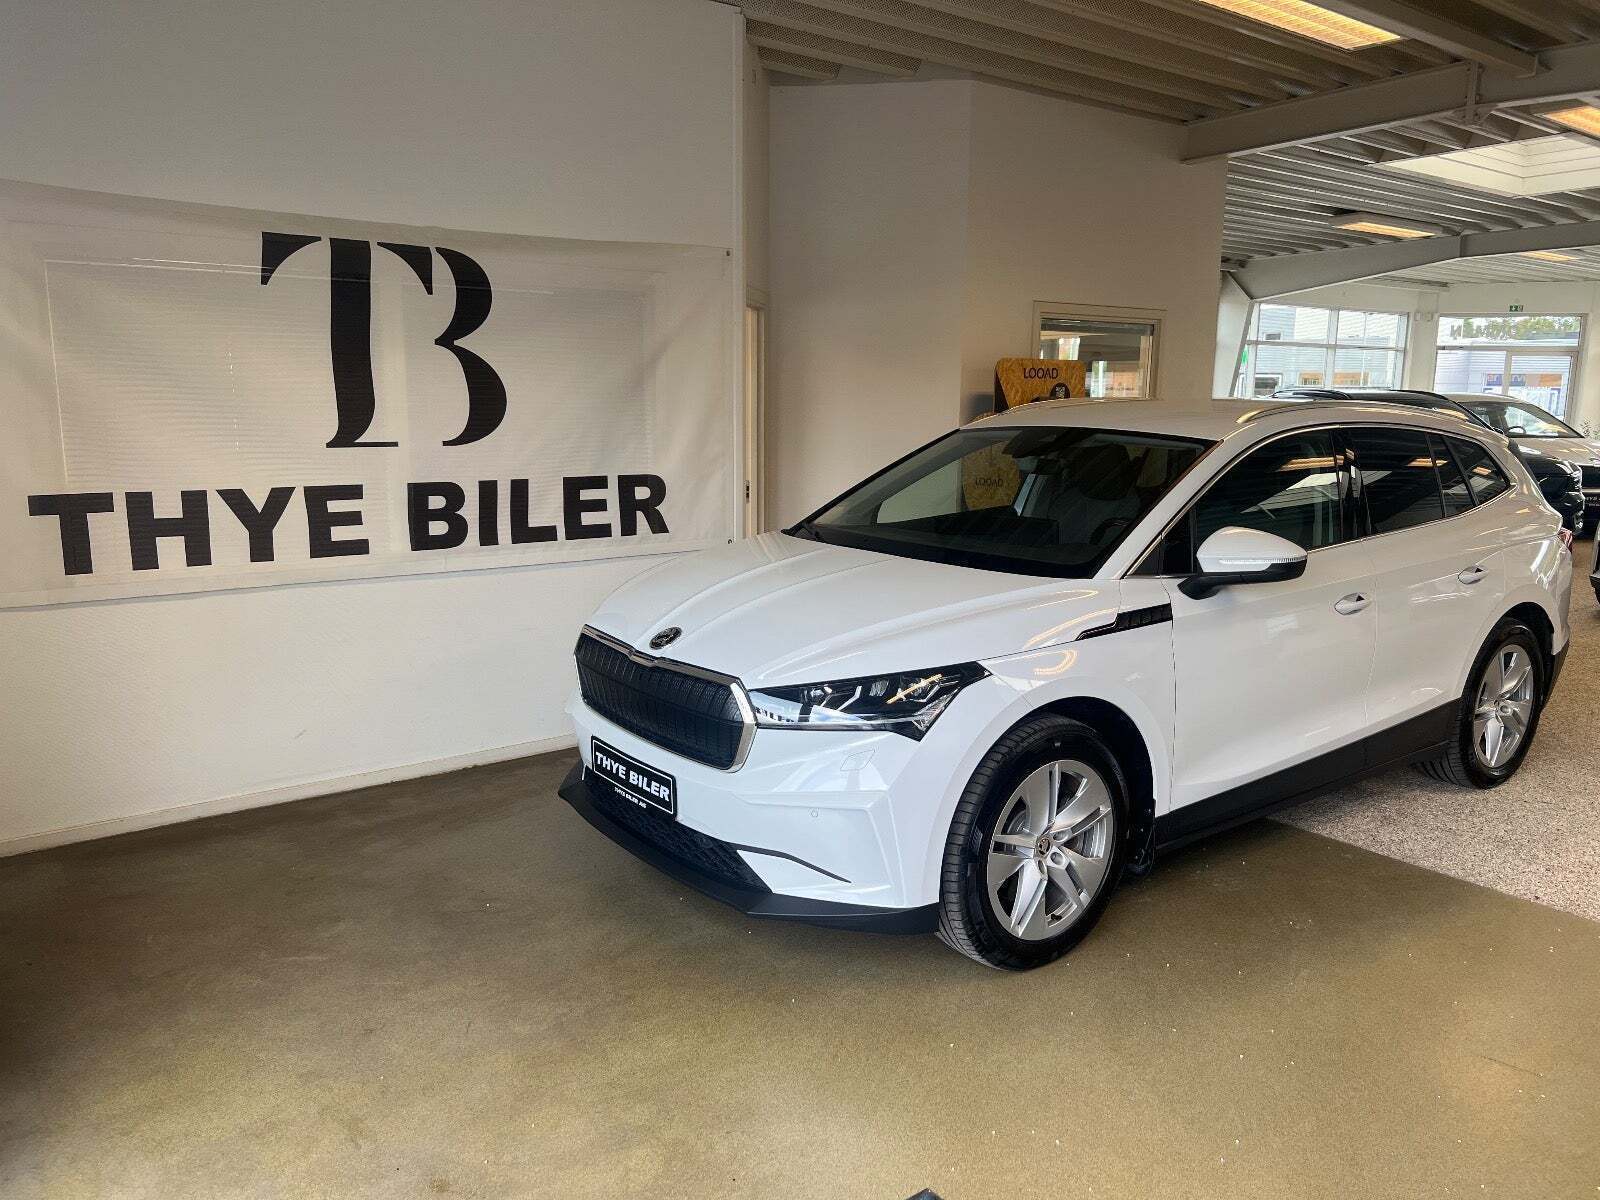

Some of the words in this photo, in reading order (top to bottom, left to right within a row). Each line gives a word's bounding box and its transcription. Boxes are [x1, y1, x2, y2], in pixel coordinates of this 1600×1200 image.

[1023, 366, 1059, 380] LOOAD
[28, 483, 371, 577] THYE
[407, 473, 671, 553] BILER
[595, 750, 627, 780] THYE
[628, 769, 670, 802] BILER
